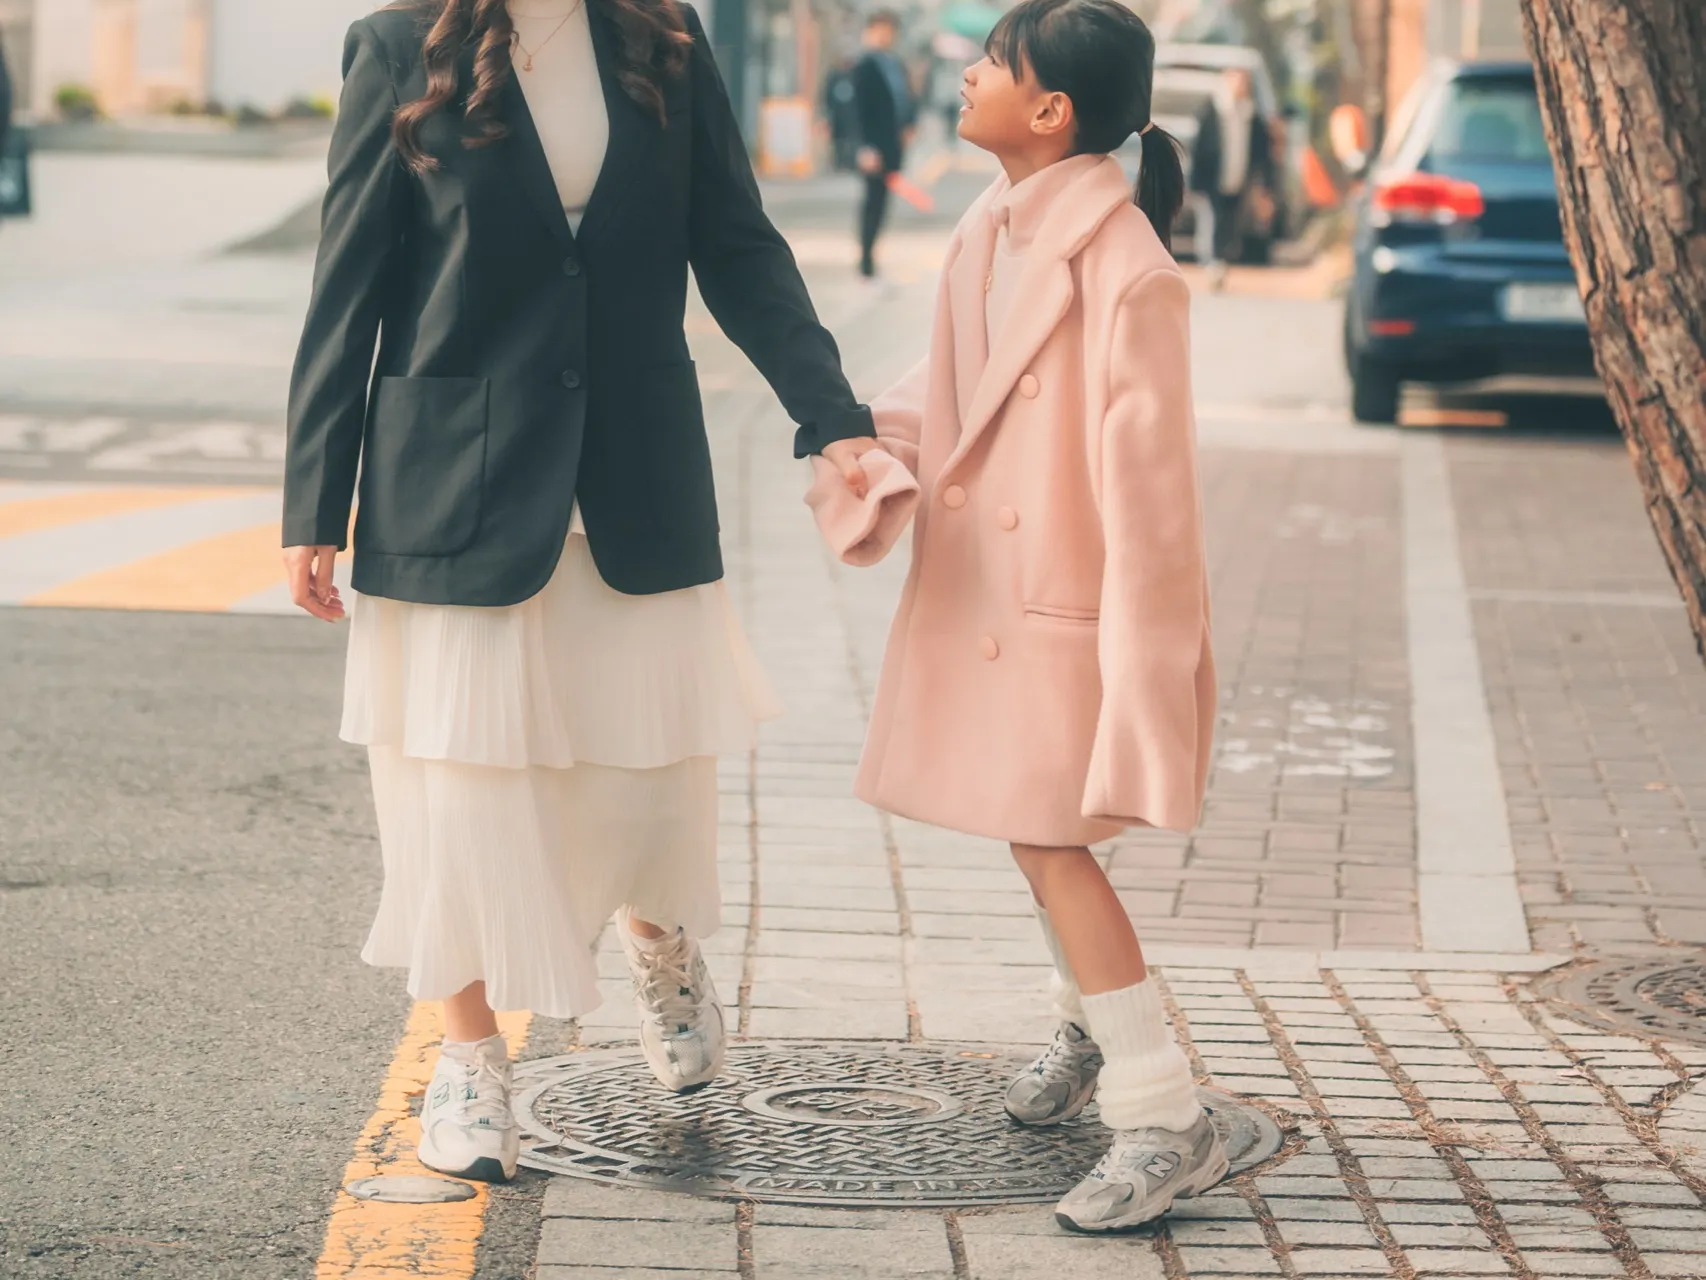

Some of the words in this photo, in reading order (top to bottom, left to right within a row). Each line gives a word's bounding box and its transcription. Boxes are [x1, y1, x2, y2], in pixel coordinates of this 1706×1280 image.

[1143, 1154, 1175, 1180] N
[756, 1177, 895, 1192] MADE
[912, 1179, 958, 1191] IN
